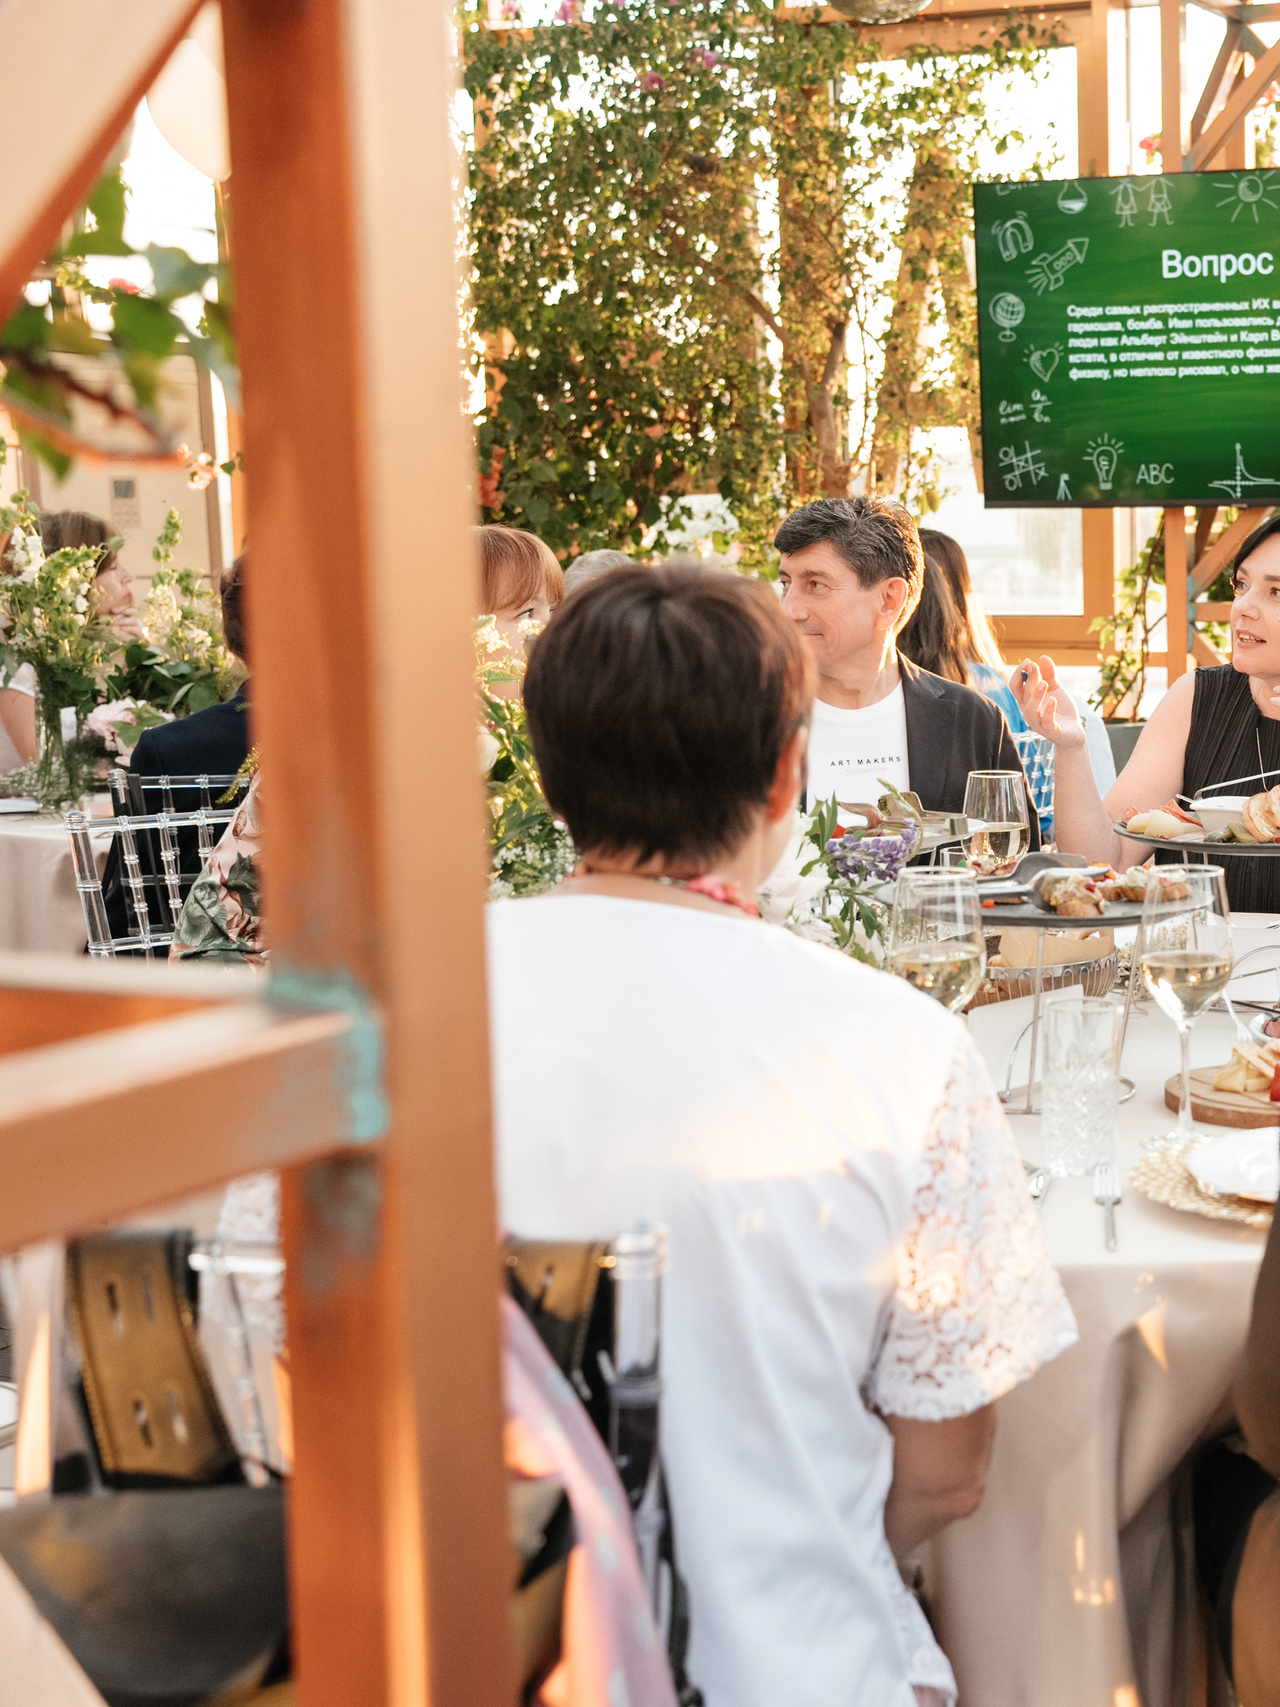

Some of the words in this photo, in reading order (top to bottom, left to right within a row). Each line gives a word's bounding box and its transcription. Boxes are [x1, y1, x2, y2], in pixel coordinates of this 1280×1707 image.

[1162, 249, 1274, 284] Вопрос
[1067, 304, 1103, 318] Среди
[1105, 304, 1141, 315] самых
[1143, 301, 1250, 316] распространенных
[1252, 298, 1270, 310] ИХ
[1067, 321, 1125, 335] гармошка,
[1127, 318, 1166, 331] бомба.
[1168, 317, 1193, 329] Ими
[1195, 315, 1275, 328] пользовались
[1068, 337, 1098, 349] люди
[1100, 337, 1119, 347] как
[1120, 333, 1167, 348] Альберт
[1169, 331, 1228, 345] Эйнштейн
[1230, 333, 1238, 343] и
[1240, 330, 1269, 345] Карл
[1069, 353, 1108, 364] кстати,
[1109, 353, 1118, 363] в
[1119, 351, 1165, 362] отличие
[1166, 350, 1180, 361] от
[1182, 349, 1245, 360] известного
[1069, 367, 1112, 381] физику,
[1113, 367, 1128, 378] но
[1130, 366, 1177, 377] неплохо
[1178, 365, 1229, 379] рисовал,
[1230, 365, 1240, 375] о
[1241, 364, 1264, 375] чем
[1136, 462, 1175, 485] ABC
[857, 756, 901, 765] MAKERS
